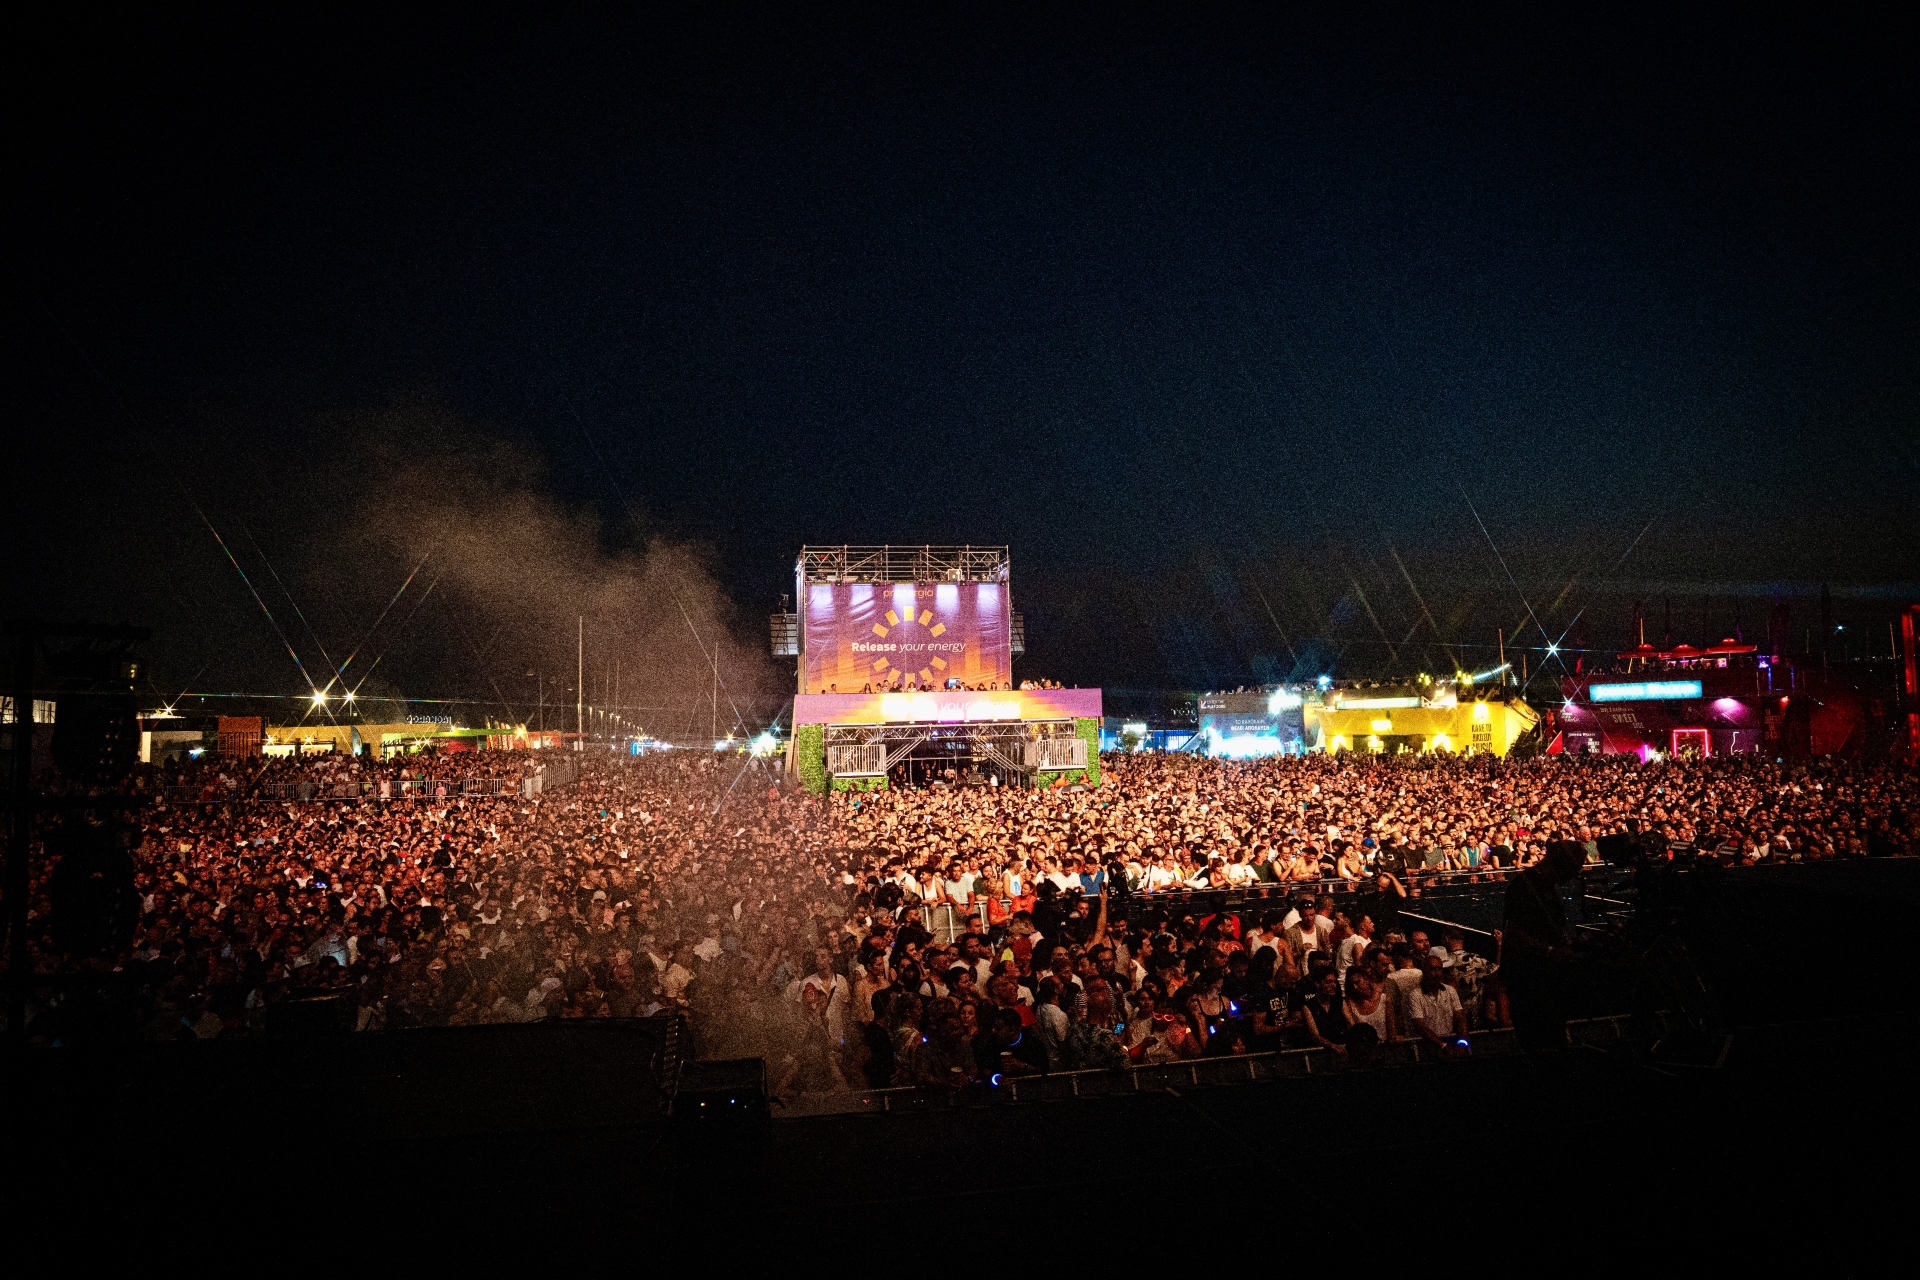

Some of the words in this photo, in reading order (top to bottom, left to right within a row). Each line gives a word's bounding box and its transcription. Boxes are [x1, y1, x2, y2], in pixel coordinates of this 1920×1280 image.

[882, 588, 934, 599] prrgia
[851, 642, 897, 653] Release
[898, 643, 925, 654] your
[927, 642, 966, 654] energy
